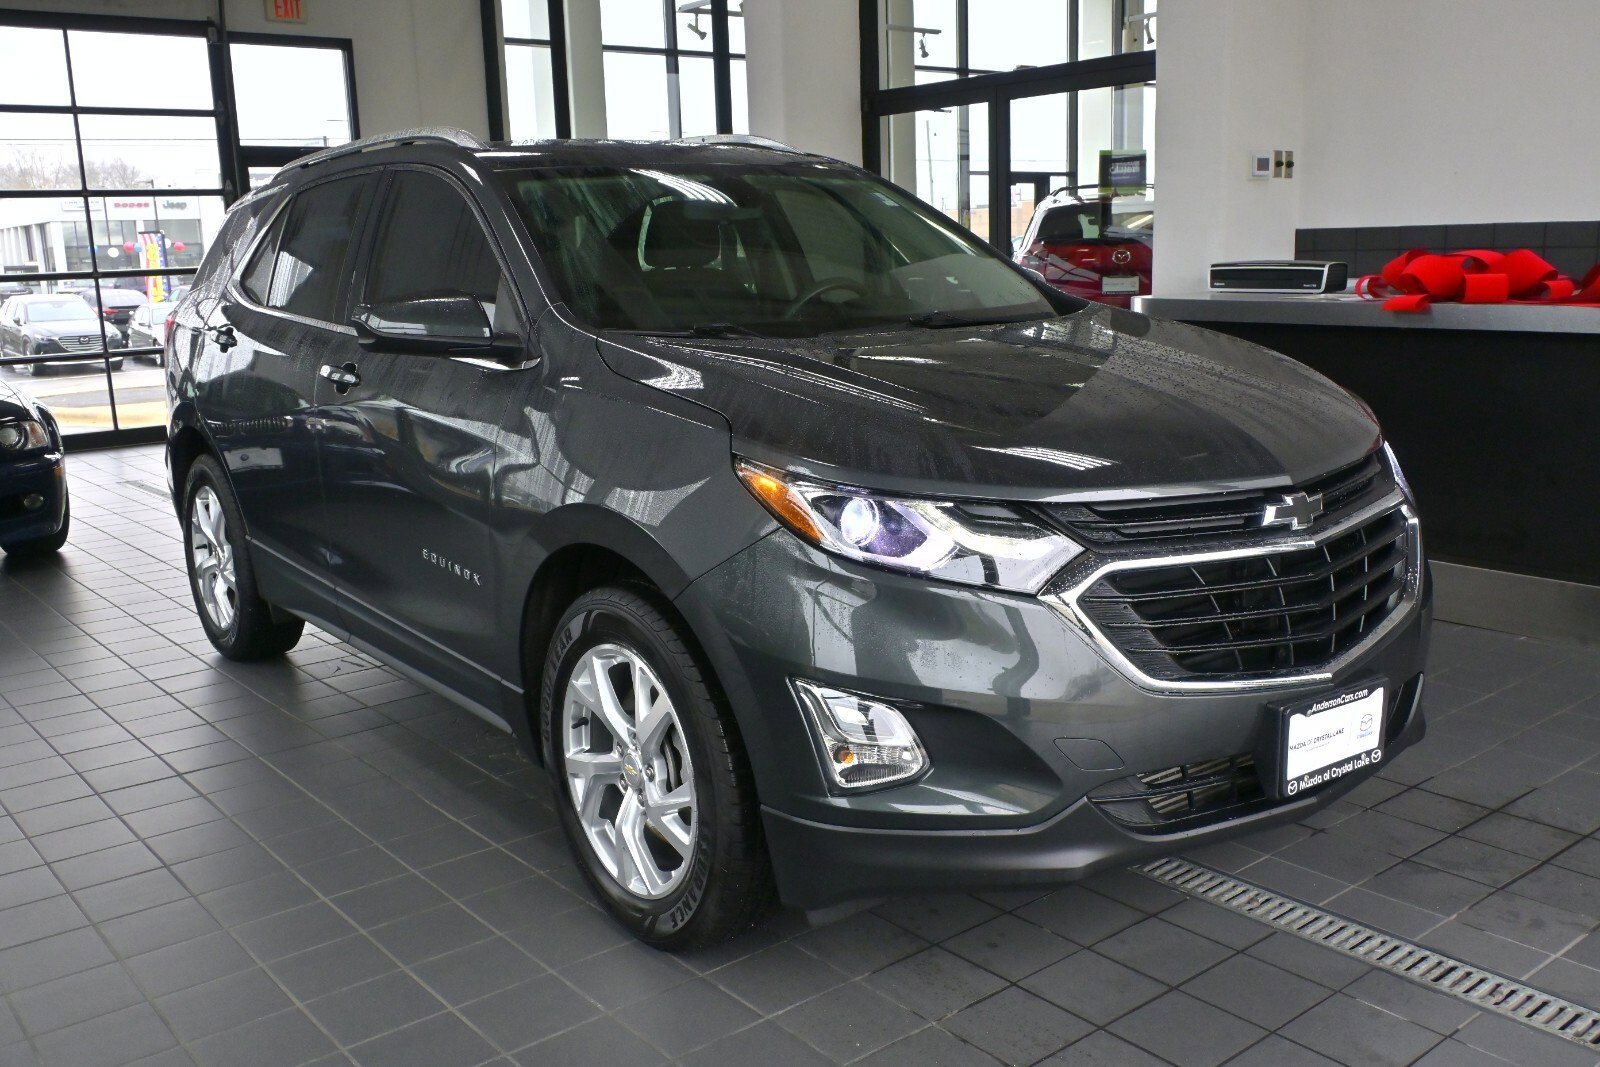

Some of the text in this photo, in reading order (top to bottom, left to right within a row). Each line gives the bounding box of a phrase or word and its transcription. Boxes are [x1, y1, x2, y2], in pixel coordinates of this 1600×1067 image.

[274, 0, 301, 18] EXIT
[163, 200, 187, 210] Jeep
[422, 548, 480, 586] EQUINOX
[1311, 689, 1368, 713] AndersonCars.com
[1299, 757, 1370, 790] Mazda of Crystal Lake
